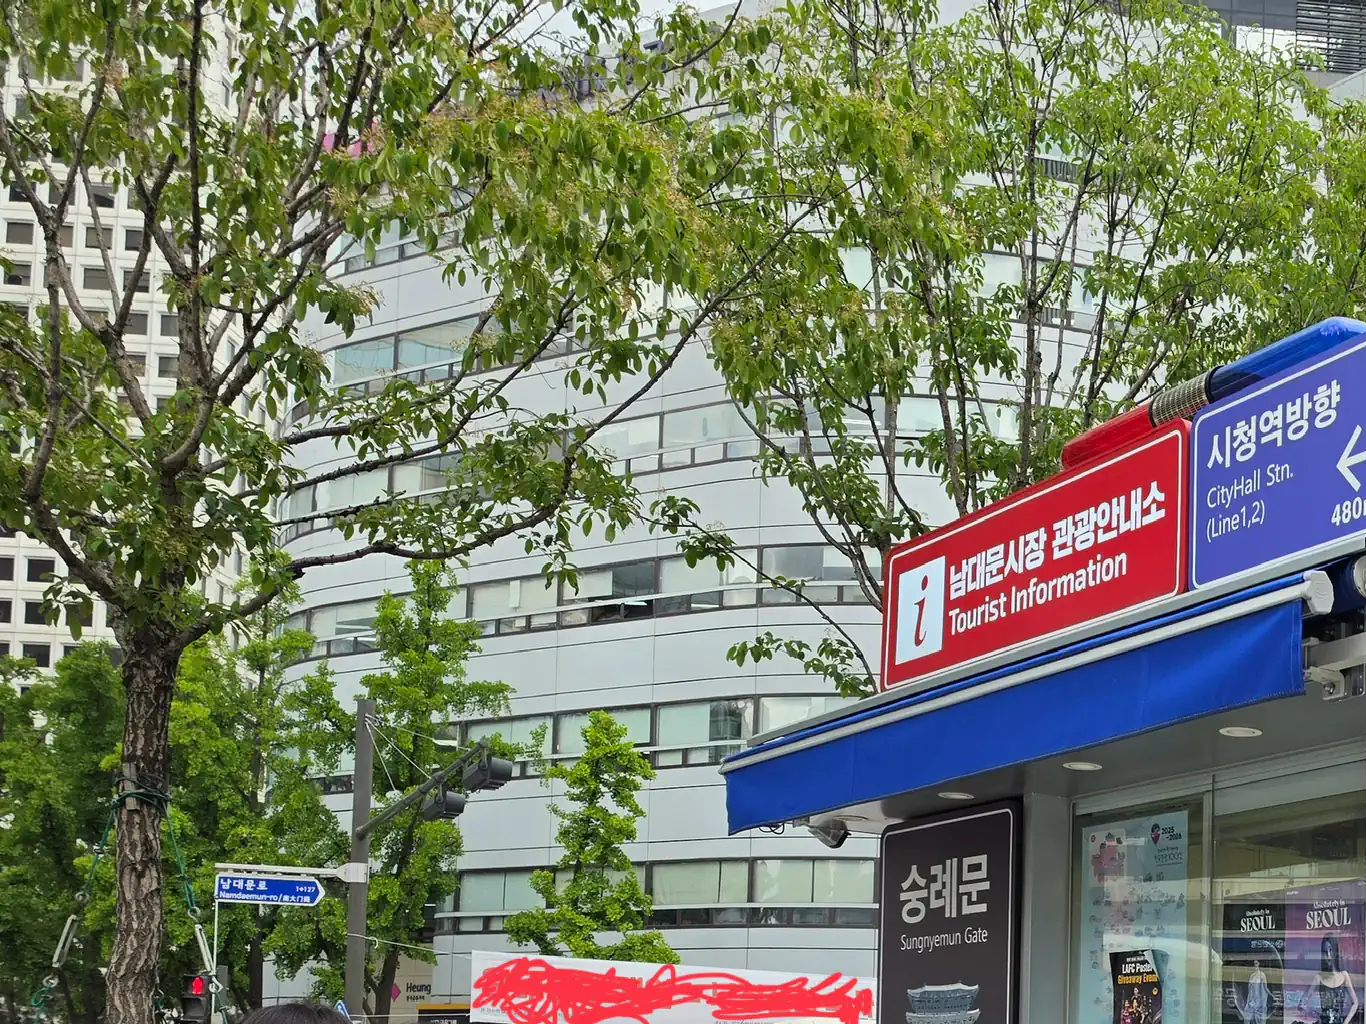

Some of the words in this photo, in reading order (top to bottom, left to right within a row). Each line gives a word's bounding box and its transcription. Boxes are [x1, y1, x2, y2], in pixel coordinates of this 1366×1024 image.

[1206, 378, 1342, 472] 시청역방향
[1206, 474, 1262, 511] CityHall
[1266, 458, 1295, 489] Stn.
[949, 527, 1047, 601] 남대문시장
[1052, 480, 1166, 561] 관광안내소
[1205, 499, 1266, 543] (Line1,2)
[949, 585, 1007, 636] Tourist
[1010, 549, 1128, 614] Information
[220, 877, 268, 891] 남대문로
[899, 853, 991, 925] 숭례문
[900, 930, 962, 954] Sungnyemun
[964, 927, 989, 945] Gate
[1240, 915, 1276, 933] SEOUL
[1306, 907, 1351, 930] SEOUL
[406, 982, 432, 995] Heung
